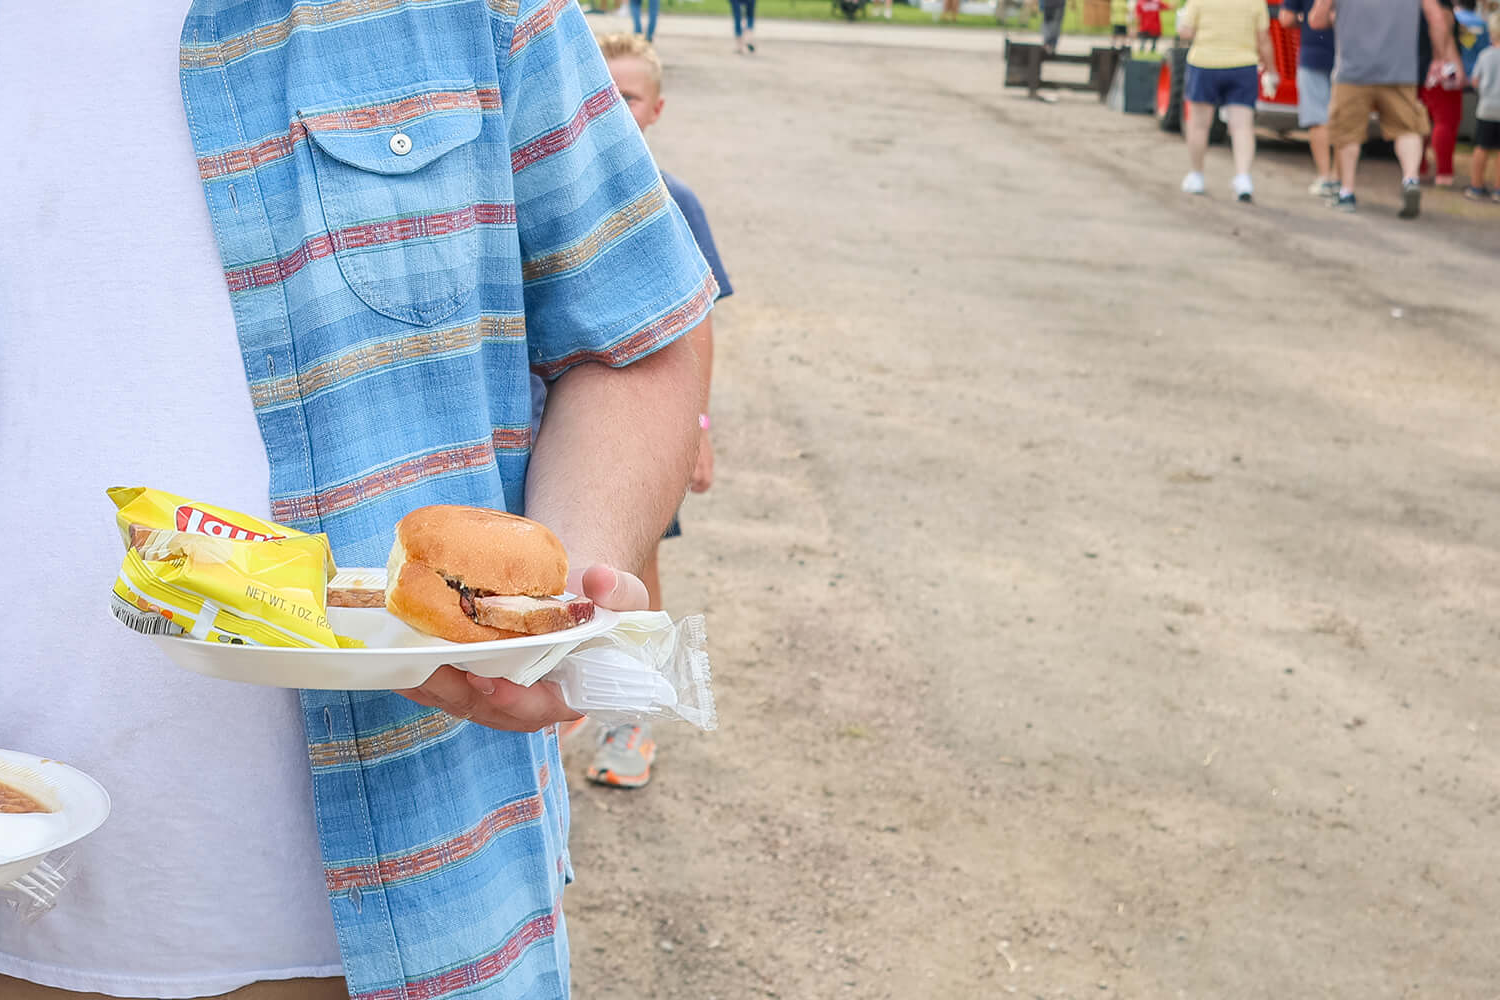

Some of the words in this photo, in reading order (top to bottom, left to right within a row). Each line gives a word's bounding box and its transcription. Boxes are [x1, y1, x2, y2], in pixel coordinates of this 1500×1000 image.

[245, 585, 268, 603] NET
[269, 594, 287, 612] WT.
[291, 604, 296, 616] 1
[297, 606, 313, 622] OZ.
